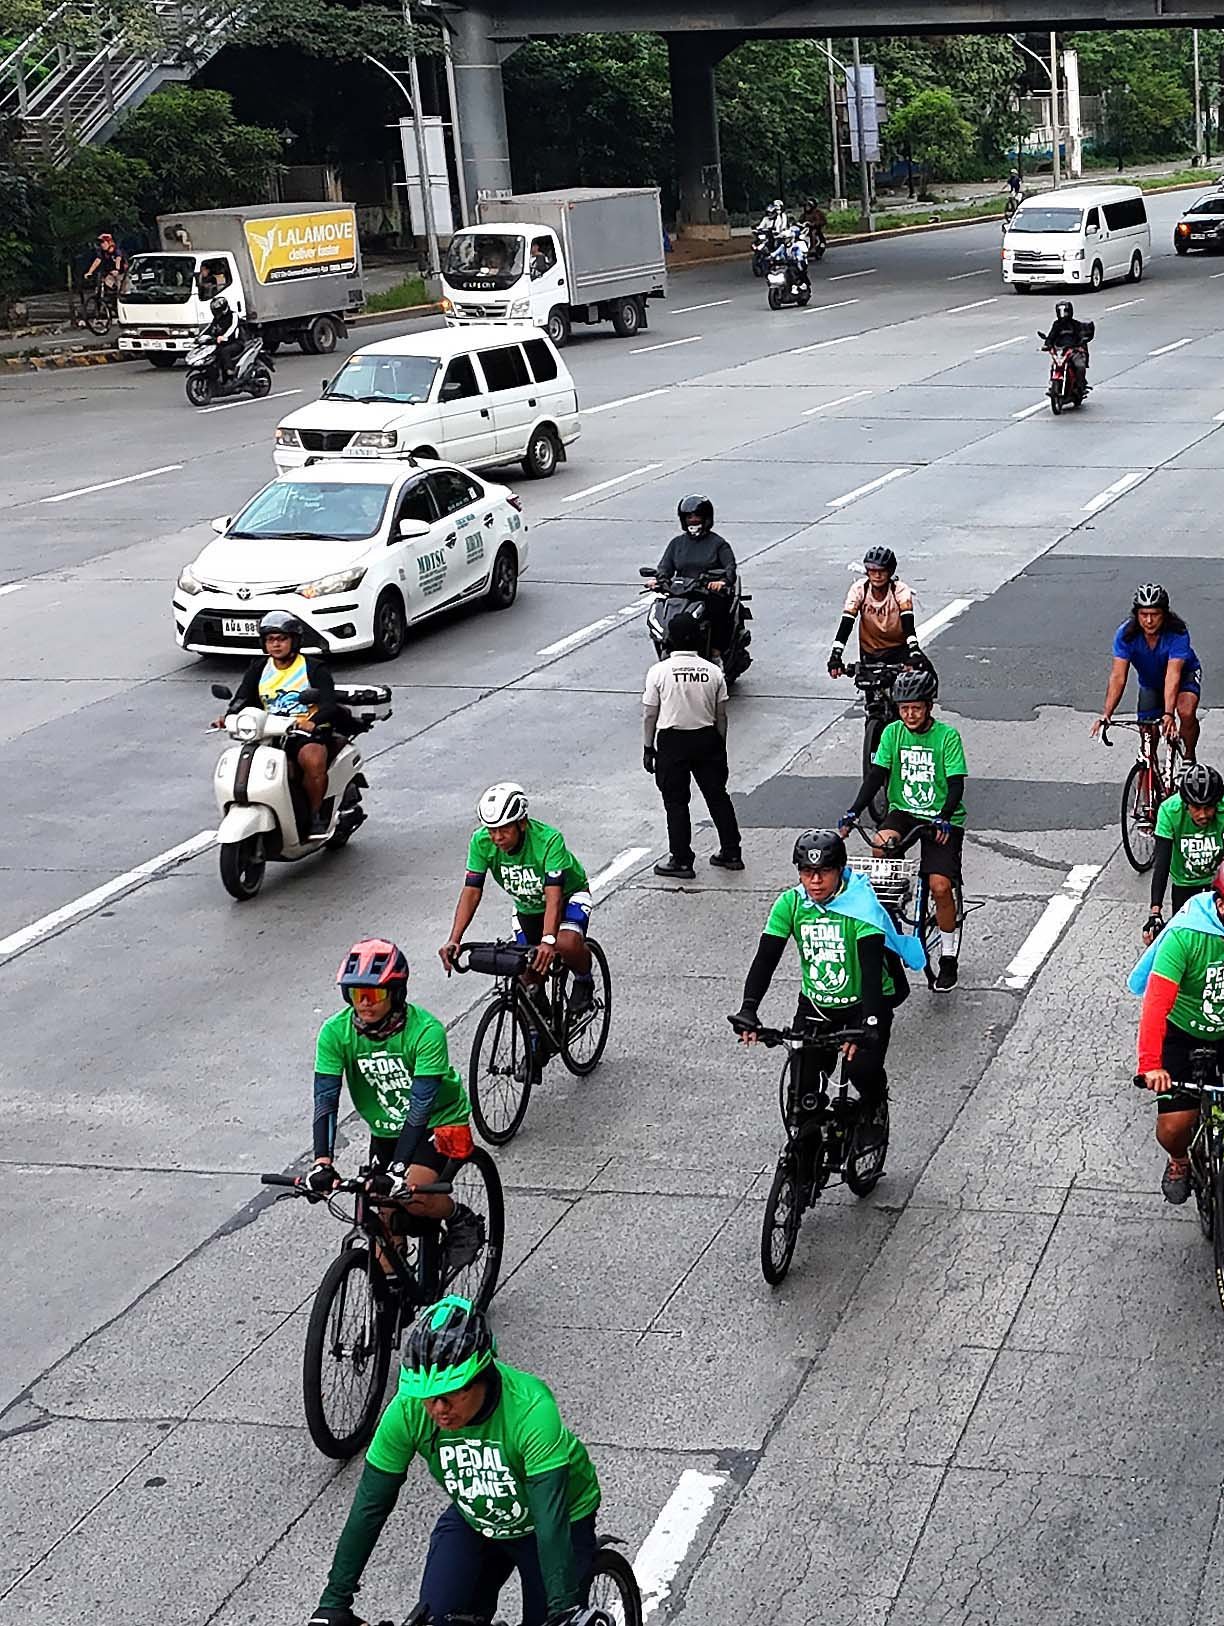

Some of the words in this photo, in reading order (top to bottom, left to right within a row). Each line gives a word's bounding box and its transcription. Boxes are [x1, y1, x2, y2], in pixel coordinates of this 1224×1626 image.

[278, 223, 353, 247] LALAMOVE
[672, 672, 709, 683] TTMD
[901, 750, 935, 766] PEDAL
[1180, 836, 1220, 853] PEDAL
[801, 924, 845, 942] PEDAL
[802, 948, 847, 963] PLANET
[358, 1057, 409, 1076] PEDAL
[440, 1444, 510, 1472] PEDAL
[459, 1467, 479, 1479] FOR
[445, 1477, 517, 1498] PLANET
